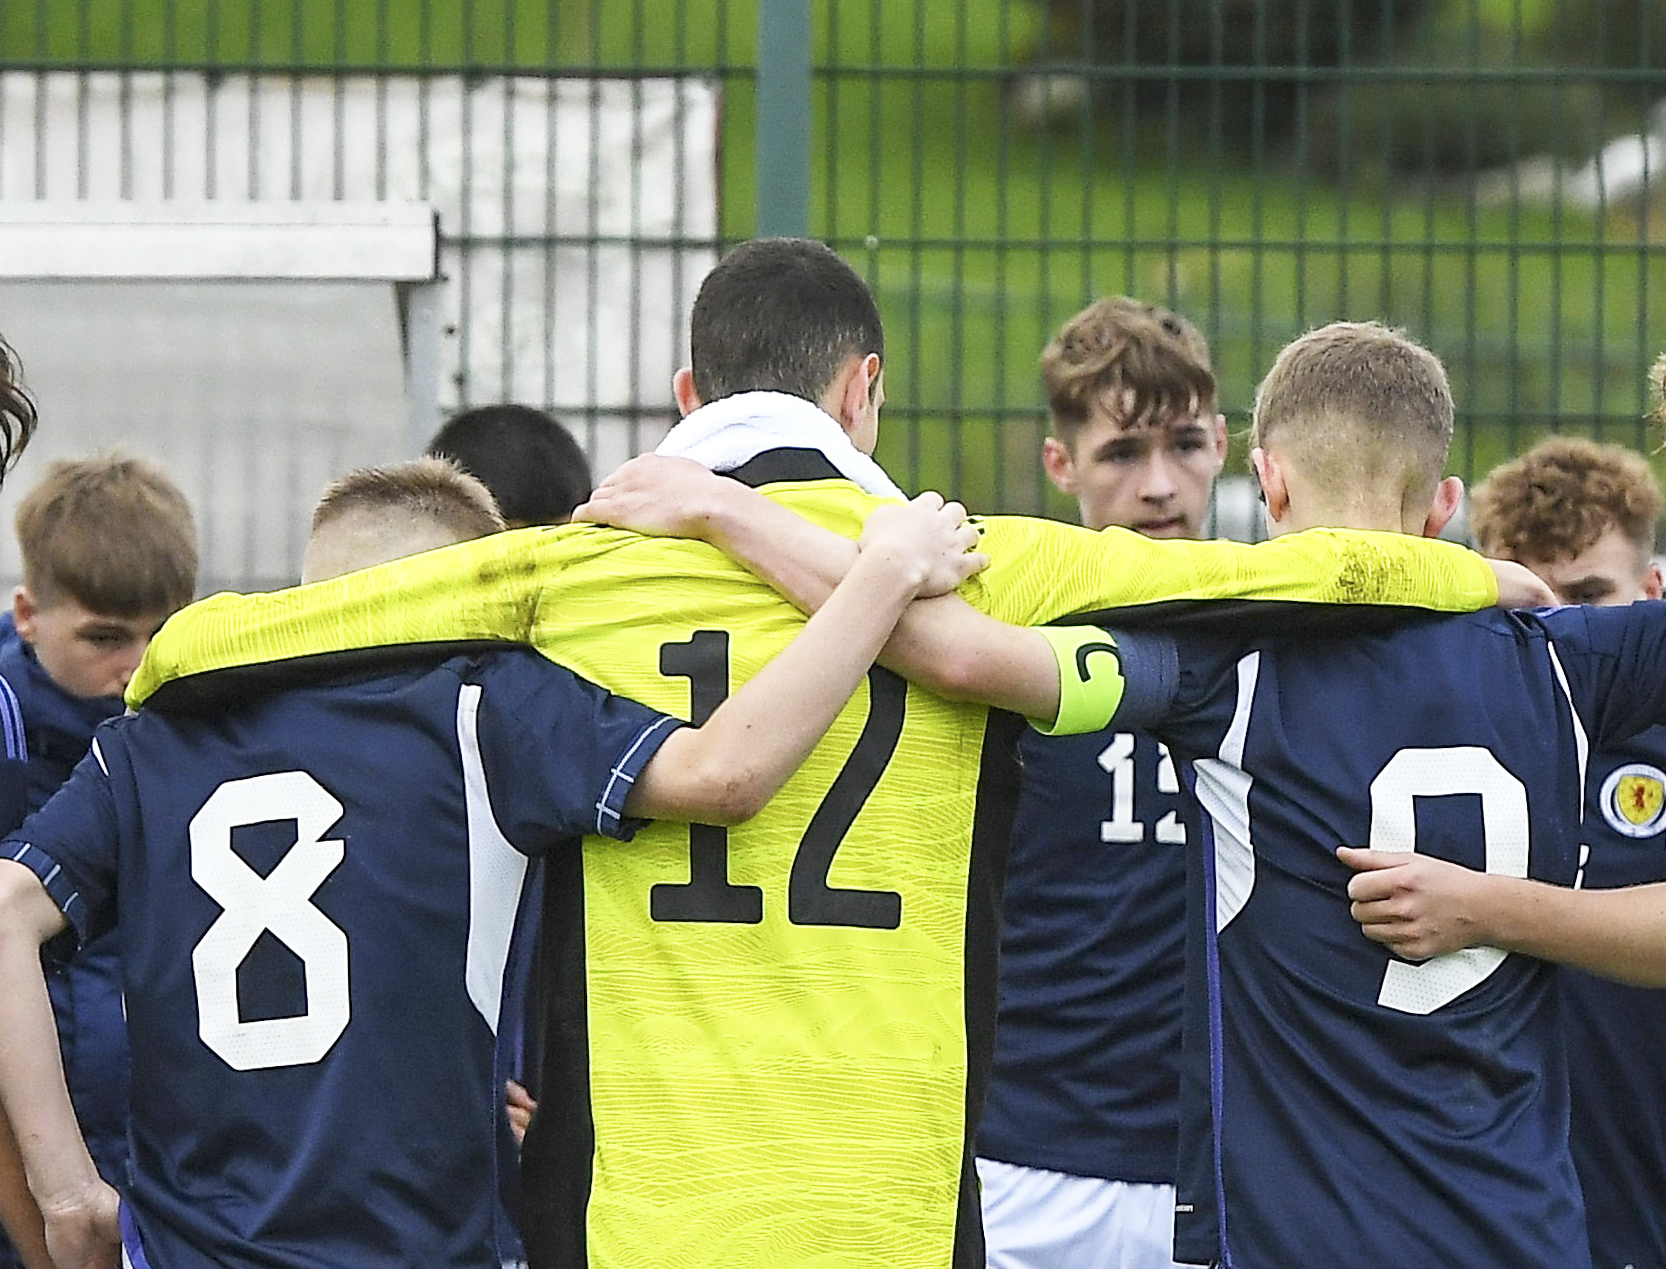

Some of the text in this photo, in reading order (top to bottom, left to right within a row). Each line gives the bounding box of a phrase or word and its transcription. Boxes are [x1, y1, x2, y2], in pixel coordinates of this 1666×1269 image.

[188, 770, 352, 1072] 8
[650, 629, 909, 930] 12
[1369, 745, 1531, 1016] 9
